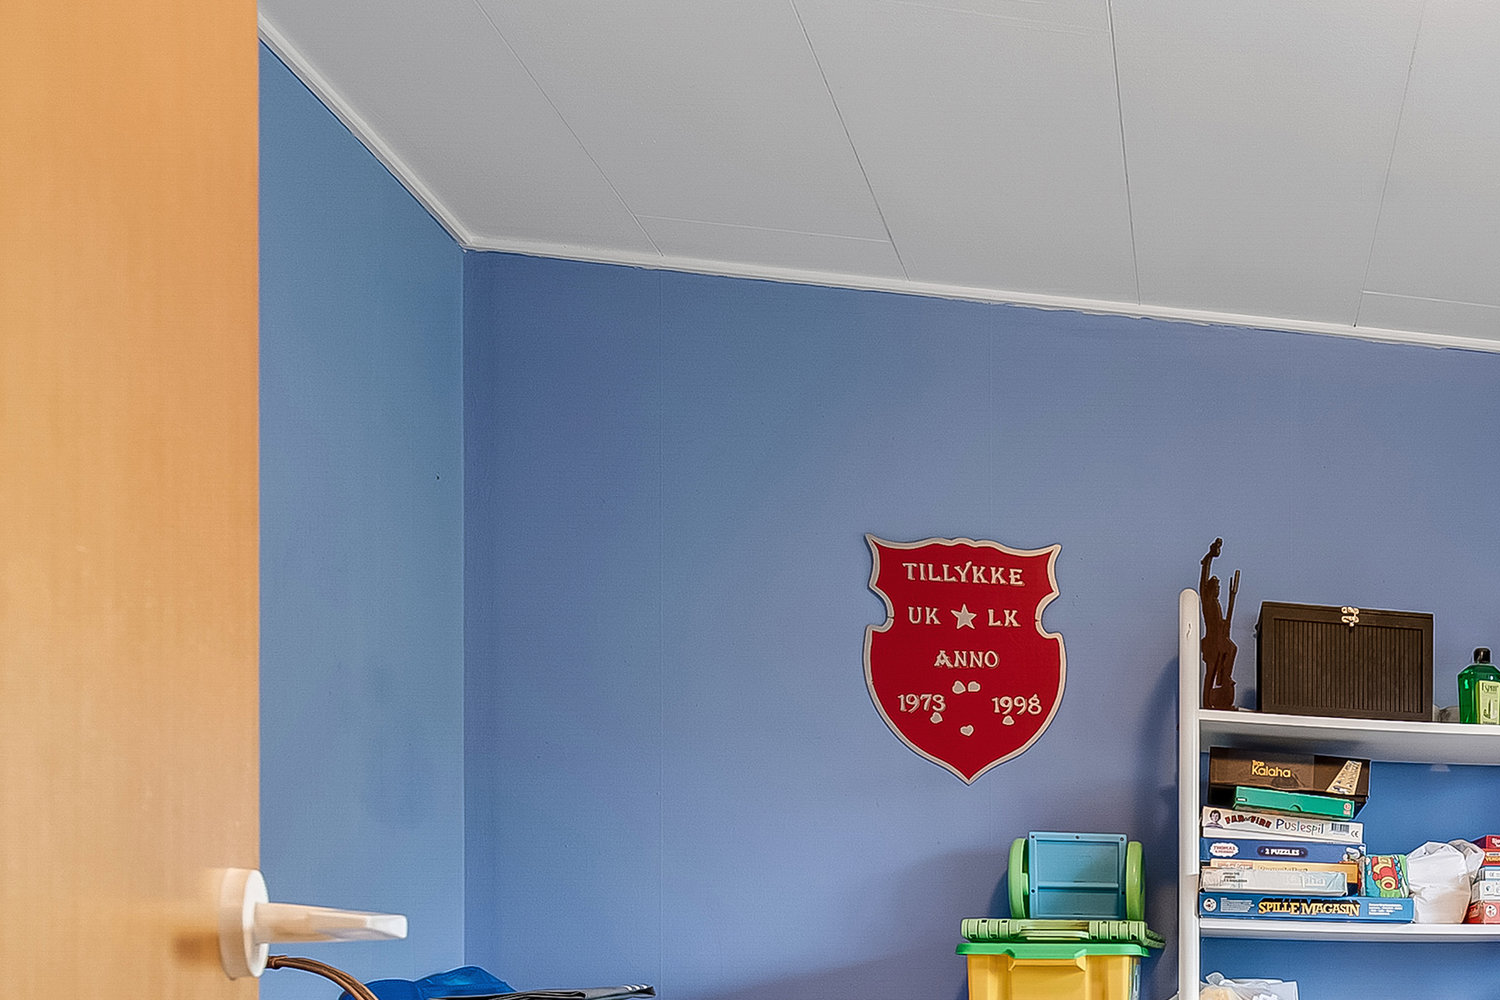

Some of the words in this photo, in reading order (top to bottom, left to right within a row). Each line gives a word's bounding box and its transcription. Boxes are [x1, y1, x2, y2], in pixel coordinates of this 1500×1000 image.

[902, 561, 1025, 586] TILLYKKE
[907, 606, 941, 625] UK
[987, 609, 1021, 628] LK
[934, 650, 1000, 669] ANNO
[897, 694, 946, 713] 1973
[991, 694, 1042, 715] 1998
[1251, 765, 1291, 778] Kalaha
[1275, 818, 1325, 836] Puslespil
[1270, 848, 1300, 856] PUZZLES
[1258, 901, 1300, 915] SPILLE
[1301, 900, 1360, 916] MAGASIN
